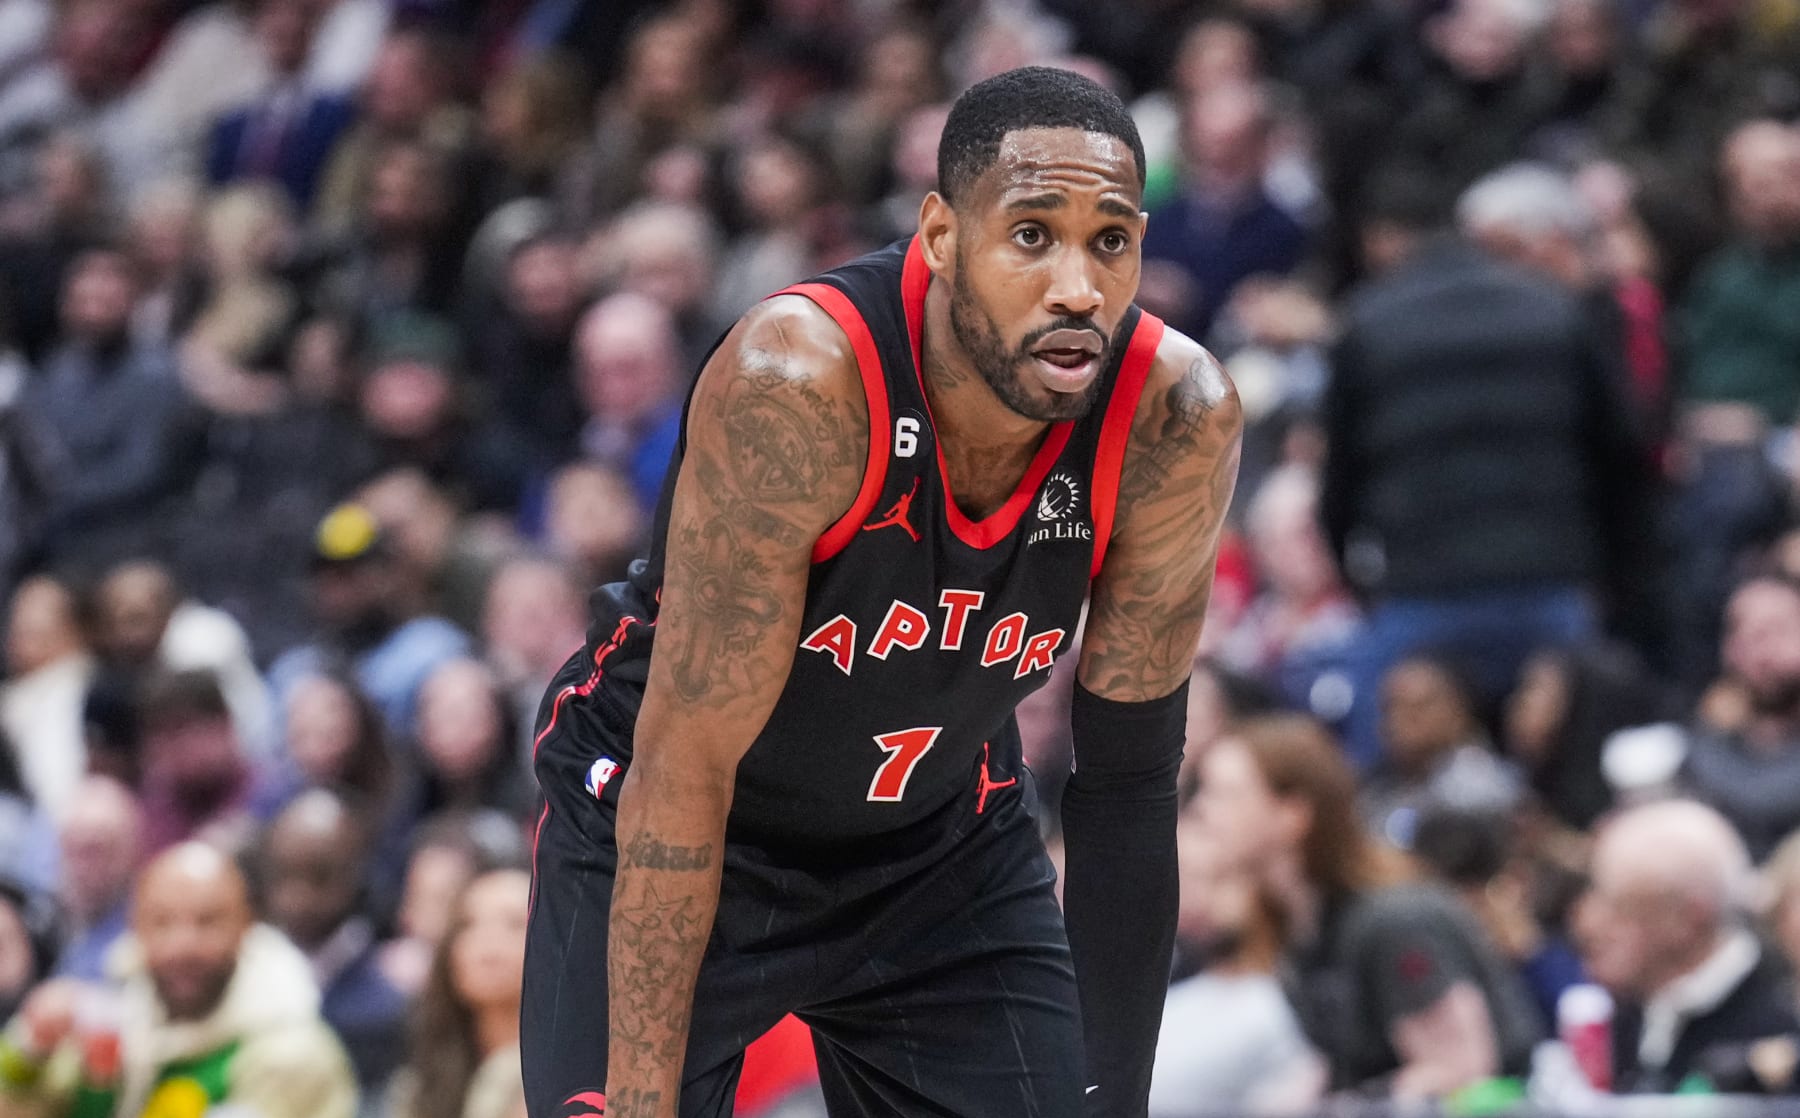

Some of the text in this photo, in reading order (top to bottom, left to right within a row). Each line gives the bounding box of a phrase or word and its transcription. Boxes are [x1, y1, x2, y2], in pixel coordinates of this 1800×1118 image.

[895, 417, 920, 458] 6
[1055, 522, 1091, 540] Life
[800, 589, 1066, 680] APTOR
